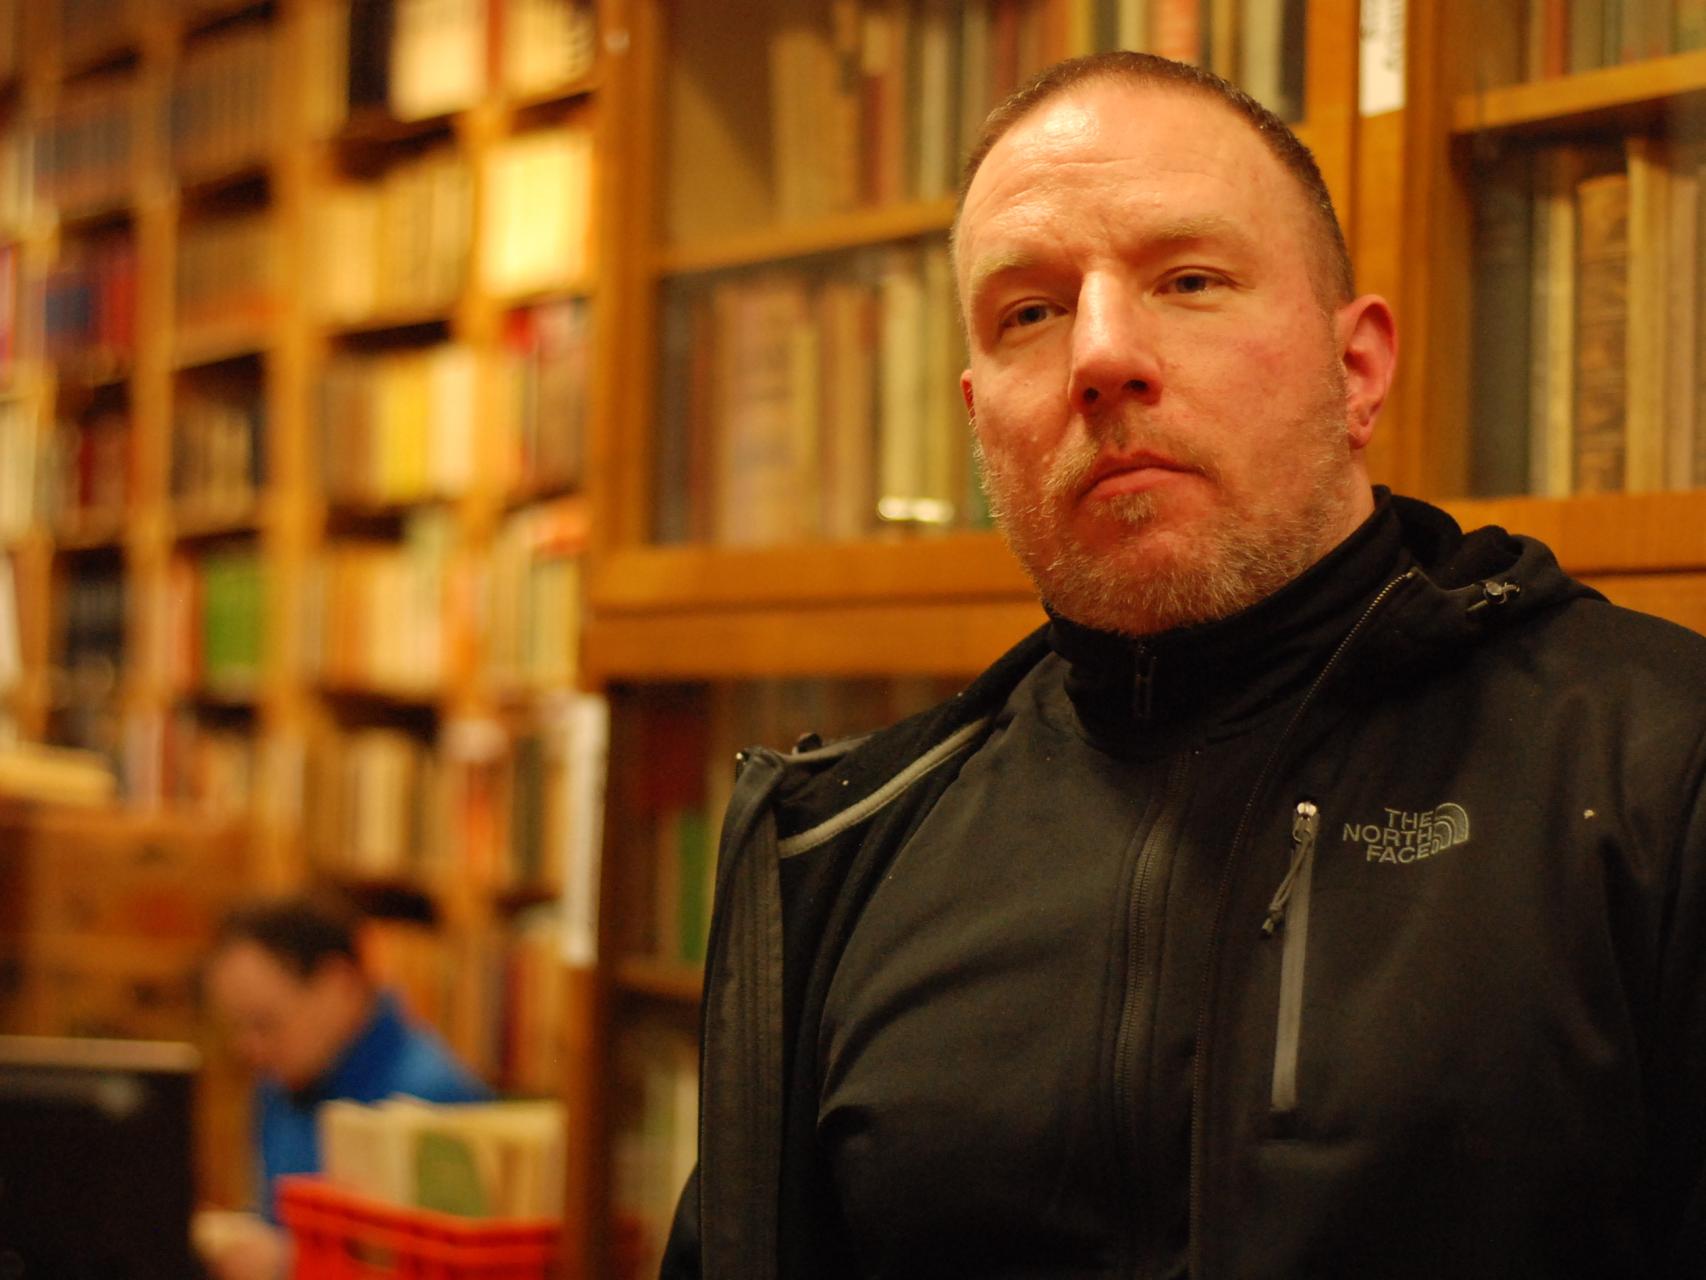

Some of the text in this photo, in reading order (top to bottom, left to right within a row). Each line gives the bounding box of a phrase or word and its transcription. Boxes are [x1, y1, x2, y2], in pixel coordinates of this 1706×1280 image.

[1384, 807, 1434, 829] THE
[1342, 823, 1433, 847] NORTH
[1366, 842, 1432, 864] FACE
